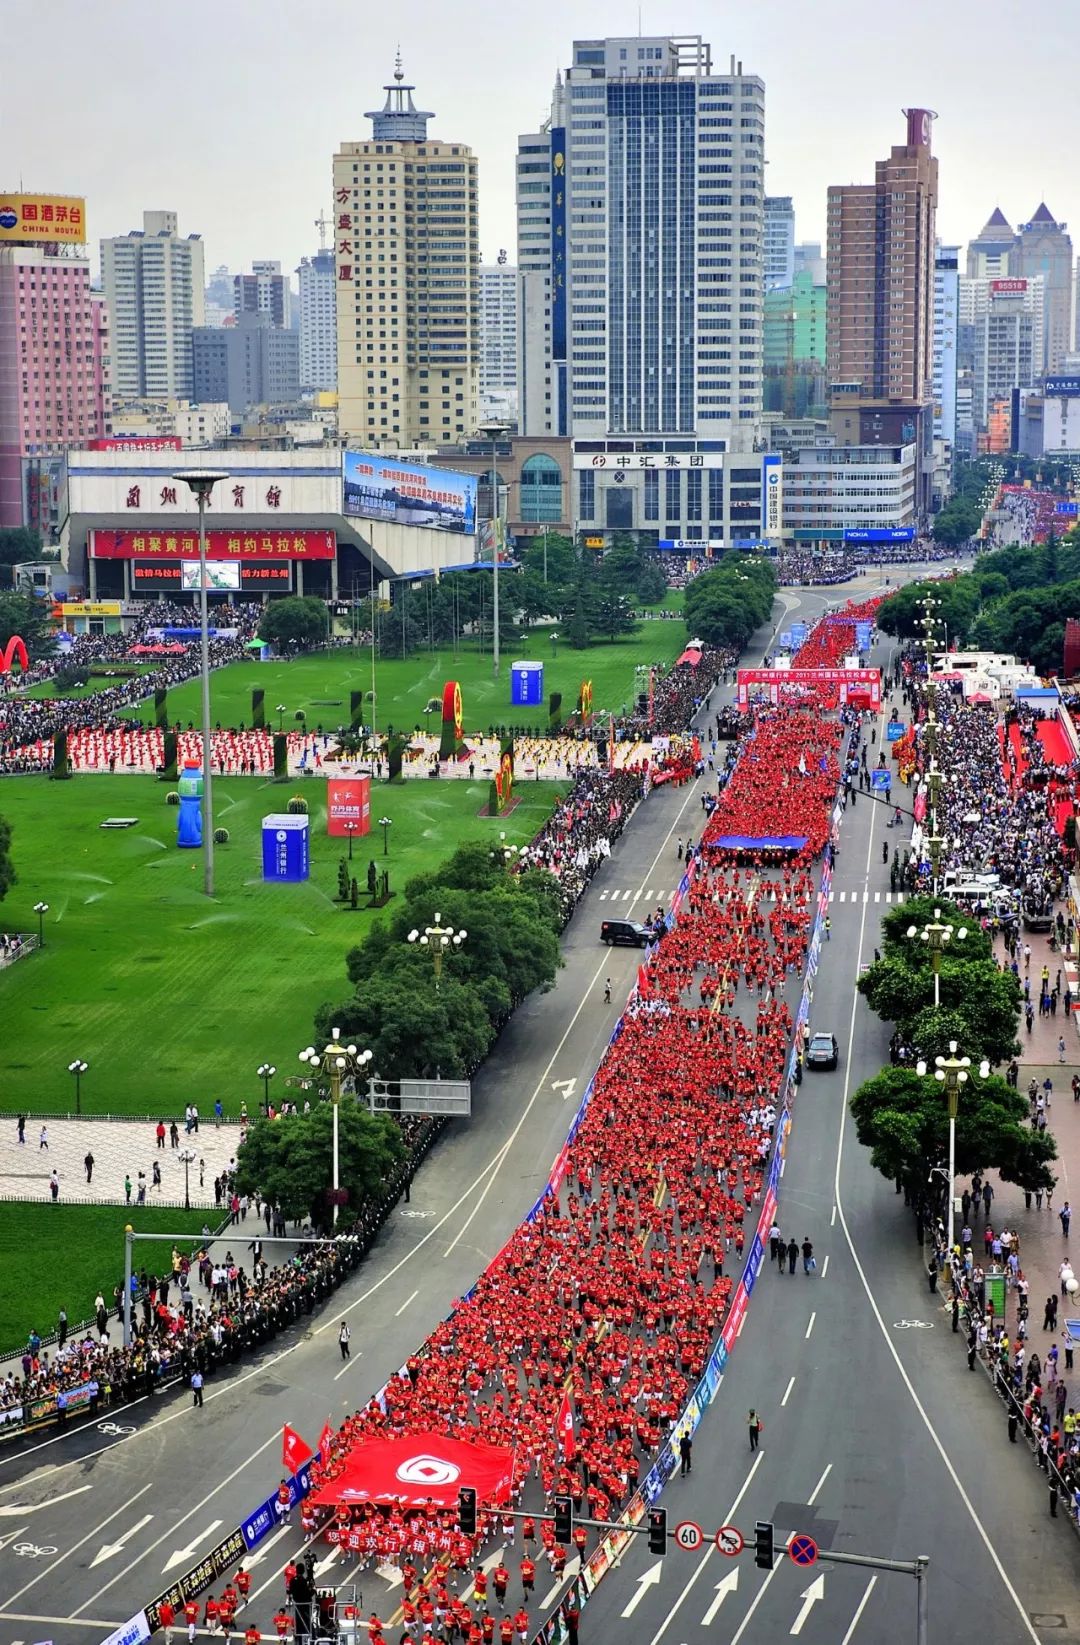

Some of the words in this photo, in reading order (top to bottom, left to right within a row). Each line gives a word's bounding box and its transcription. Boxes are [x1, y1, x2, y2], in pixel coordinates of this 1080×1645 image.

[22, 204, 81, 224] 国酒茅台
[22, 225, 49, 233] CHINA
[55, 227, 81, 236] MOUTAI
[336, 187, 353, 281] 方盛大厦
[616, 455, 704, 468] 中汇集团
[132, 537, 212, 553] 相聚黄河畔
[227, 537, 308, 553] 相约马拉松
[682, 1528, 697, 1544] 60
